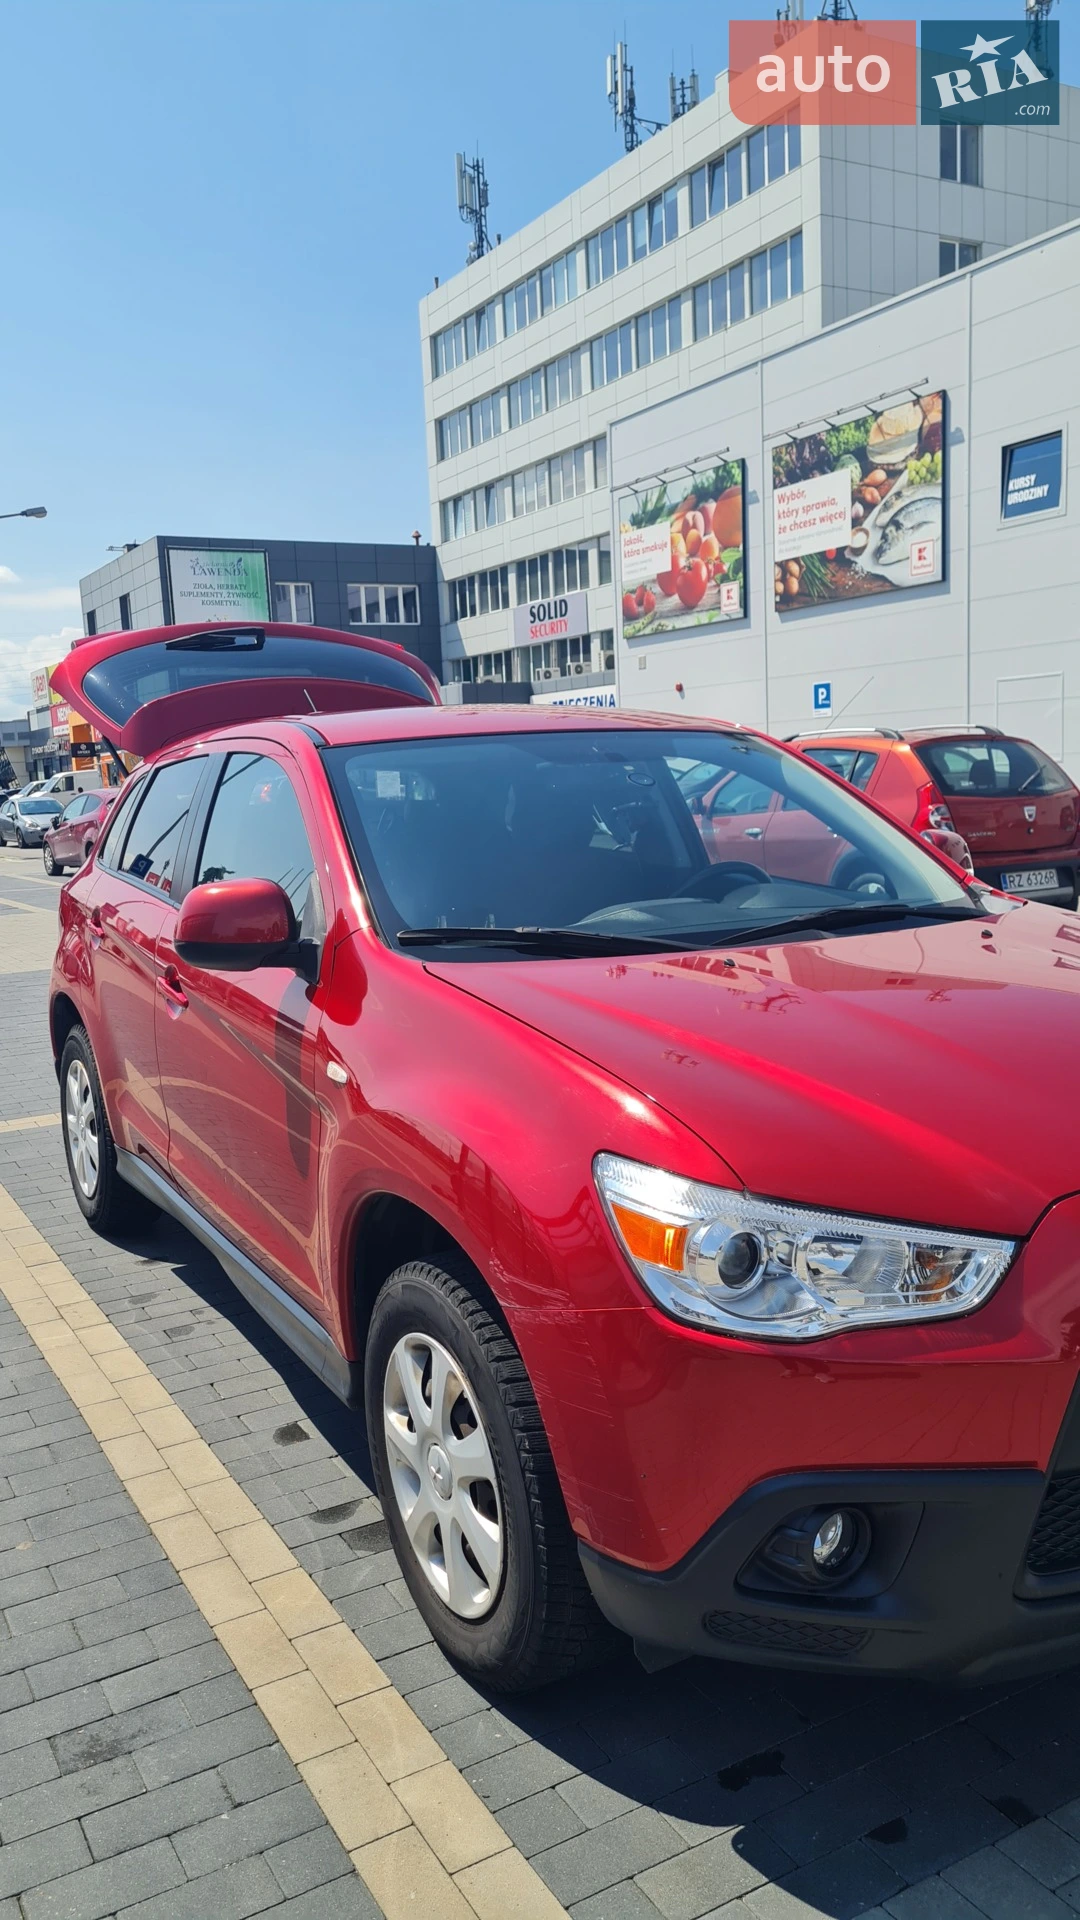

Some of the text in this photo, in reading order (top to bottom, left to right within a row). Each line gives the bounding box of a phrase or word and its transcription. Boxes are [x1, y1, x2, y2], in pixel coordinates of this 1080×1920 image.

[1008, 473, 1036, 491] KURSY
[777, 489, 806, 505] Wybór,
[1007, 484, 1049, 505] URODZINY
[777, 496, 838, 520] który sprawia,
[778, 507, 846, 534] że chcesz więcej
[193, 566, 248, 576] LAWENDA
[530, 599, 568, 624] SOLID
[530, 619, 568, 639] SECURITY
[1008, 871, 1056, 888] RZ 6326R
